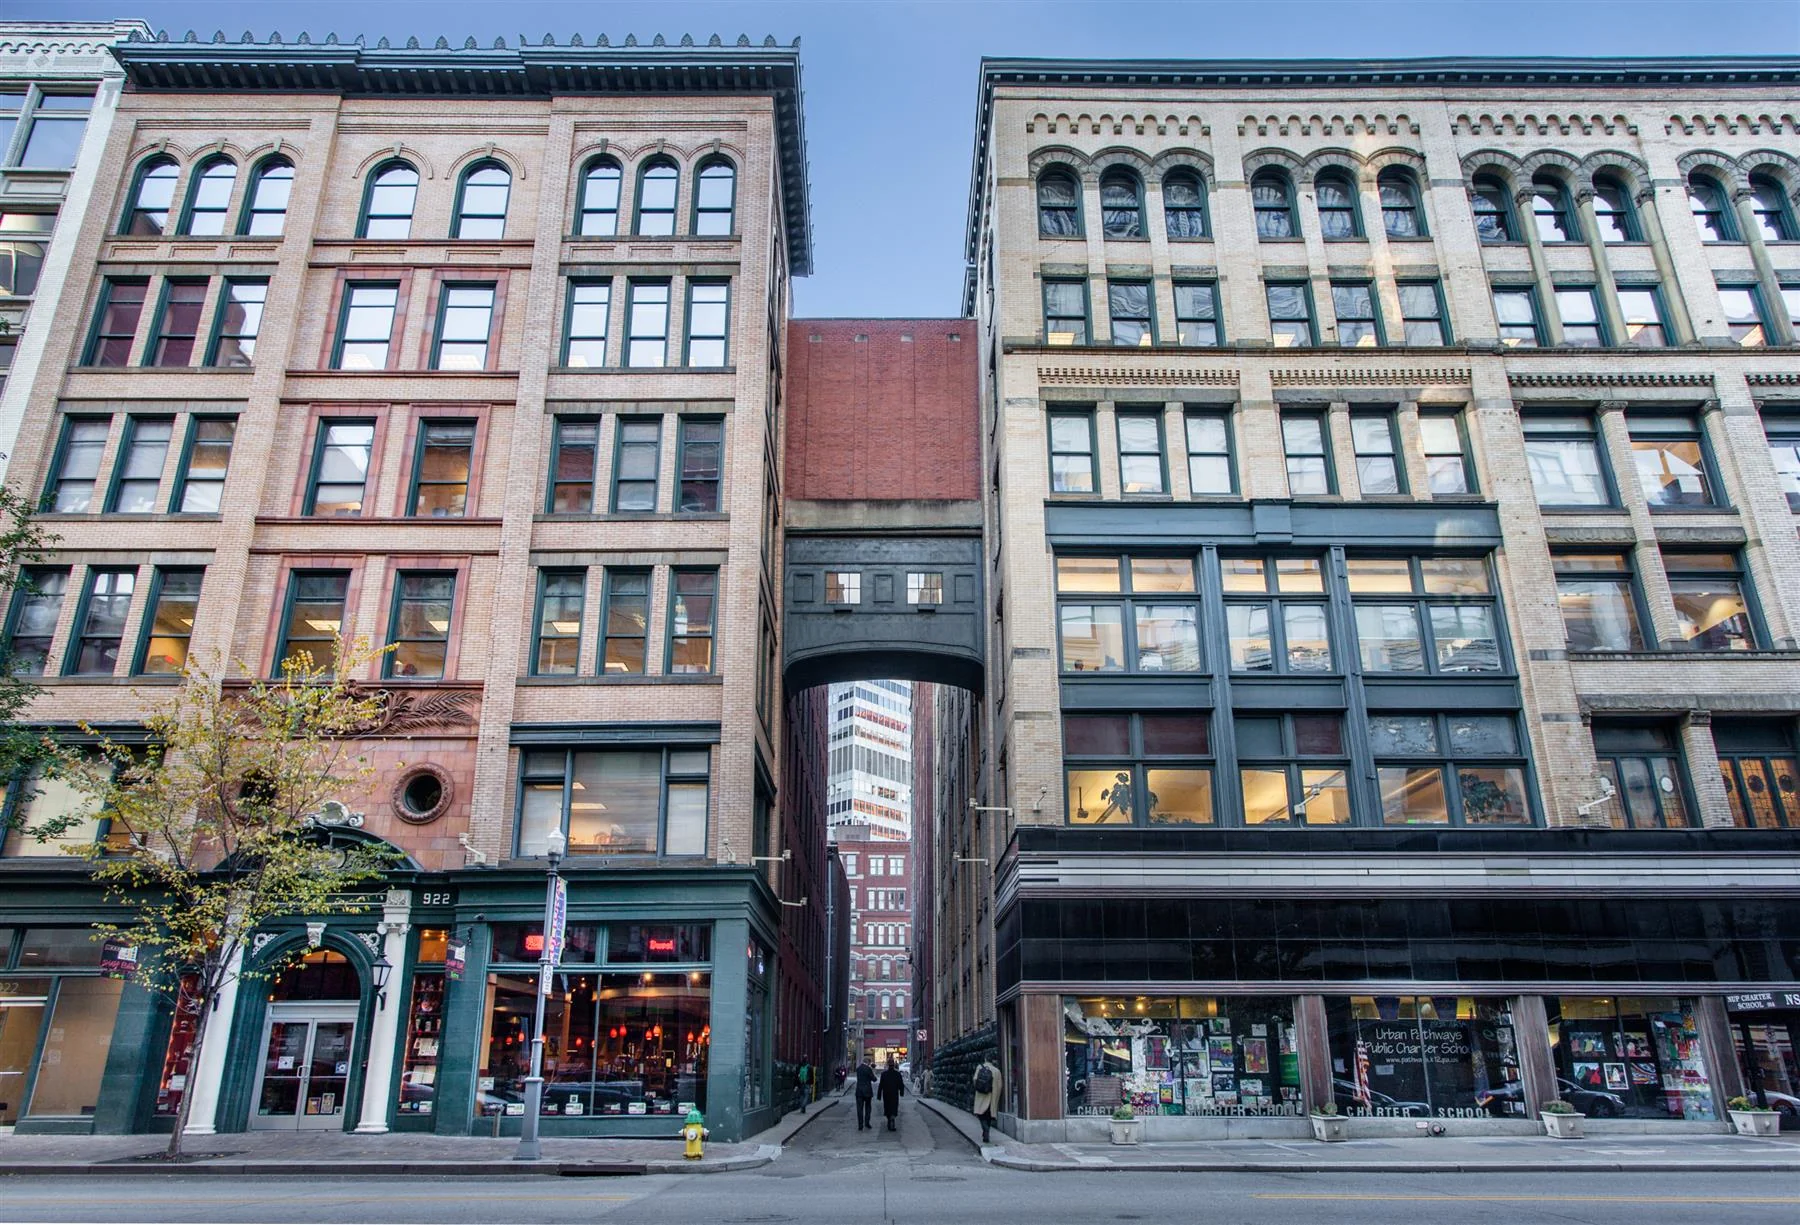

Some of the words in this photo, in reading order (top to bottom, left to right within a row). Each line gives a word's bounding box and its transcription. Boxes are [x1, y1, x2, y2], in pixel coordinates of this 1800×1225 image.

[423, 892, 451, 905] 922
[1740, 993, 1772, 1002] CHARTER
[1737, 1001, 1764, 1010] SCHOOL
[1375, 1028, 1407, 1040] Urban
[1410, 1028, 1463, 1042] Pathways
[1365, 1041, 1394, 1055] Public
[1077, 1105, 1121, 1116] CHARTE
[1249, 1103, 1299, 1116] SCHOOL
[1347, 1106, 1411, 1118] CHARTER
[1438, 1107, 1492, 1118] SCHOOL
